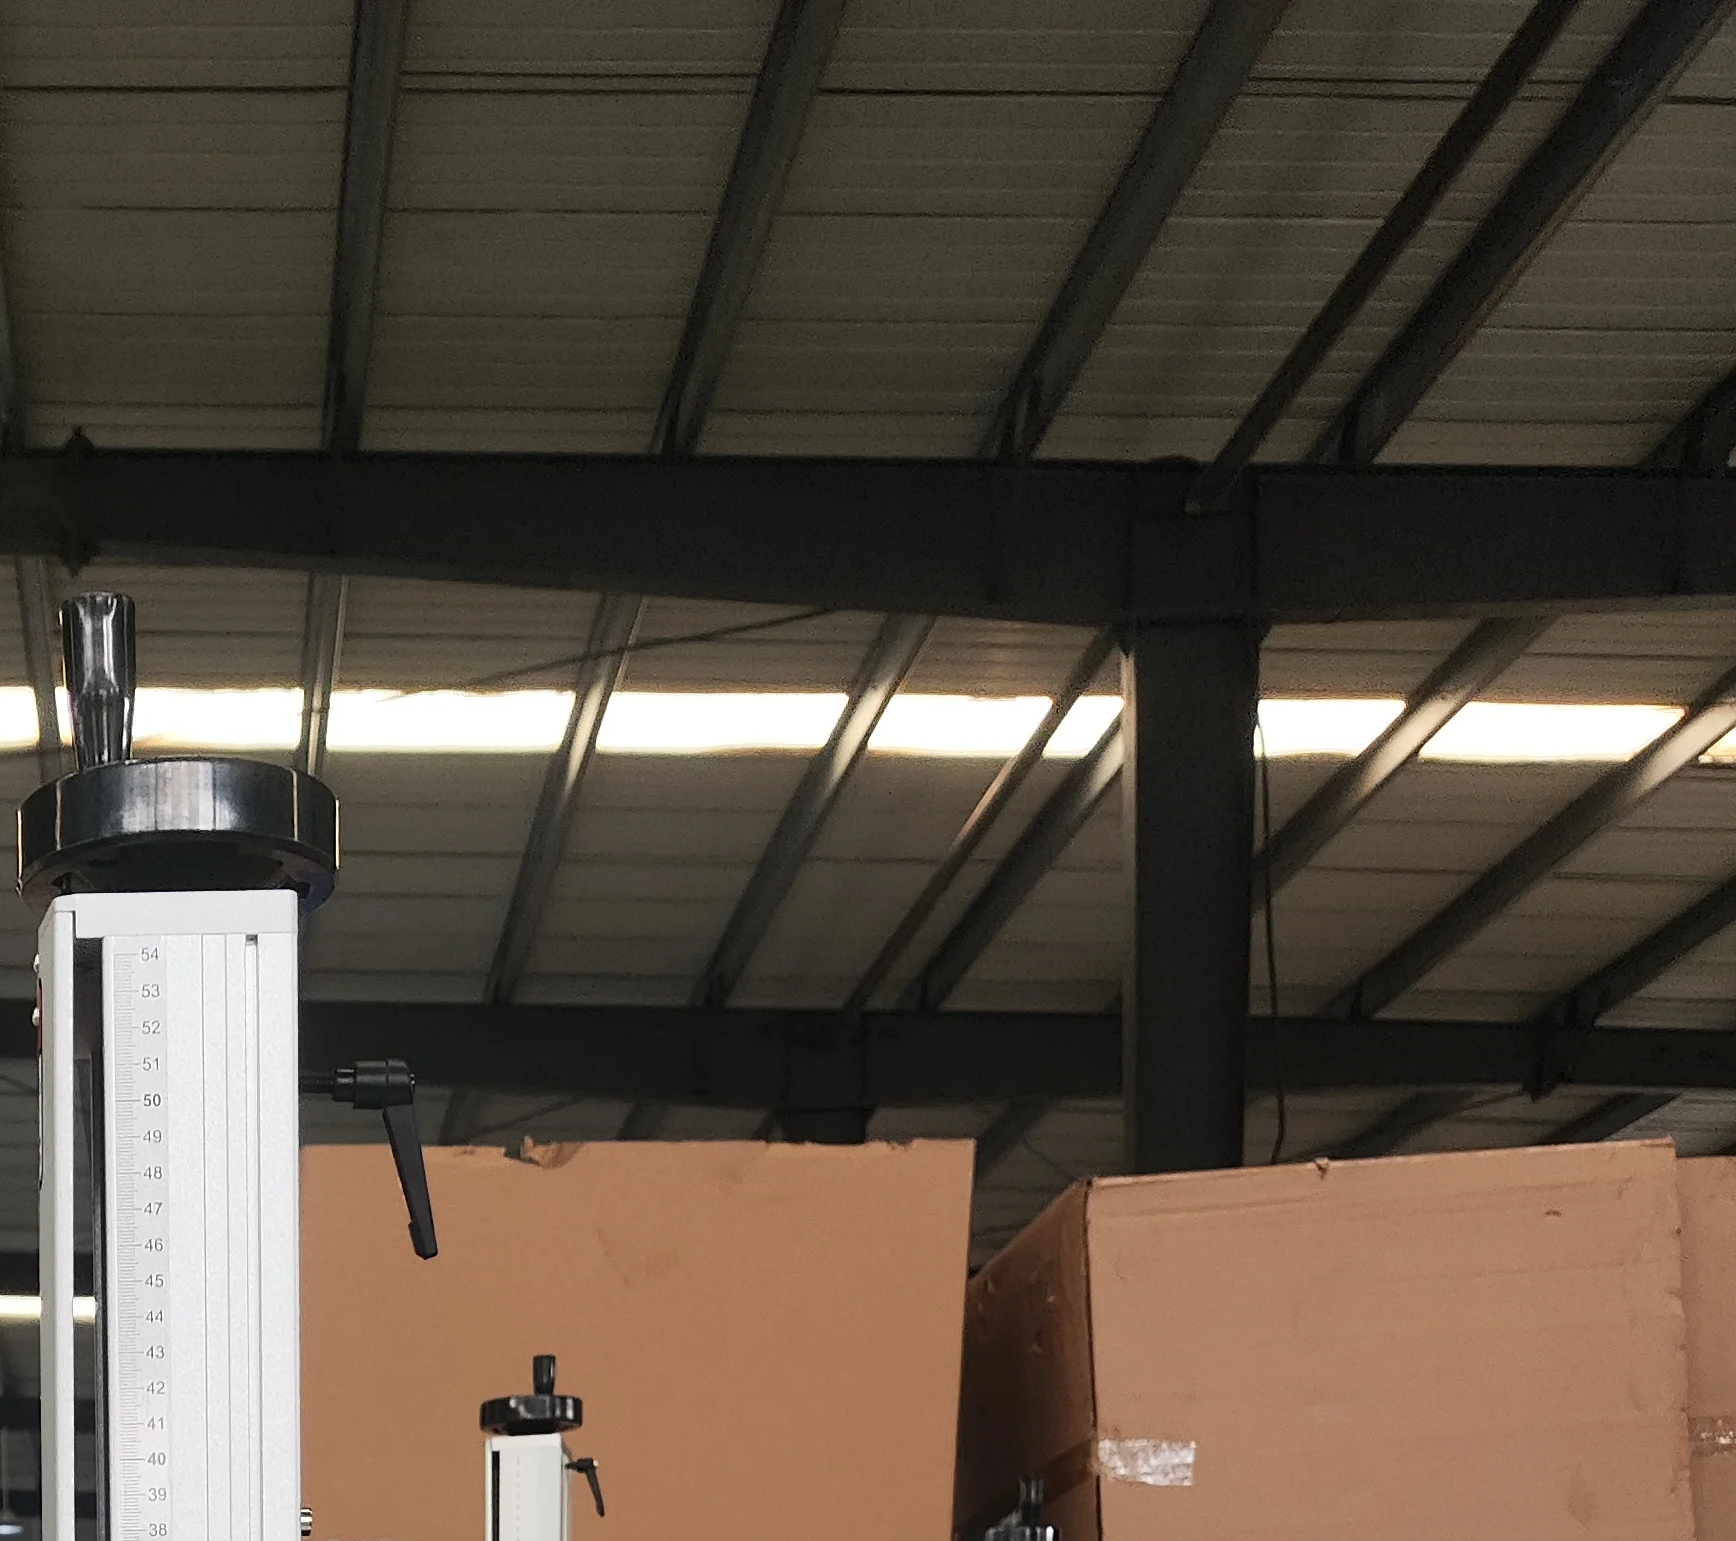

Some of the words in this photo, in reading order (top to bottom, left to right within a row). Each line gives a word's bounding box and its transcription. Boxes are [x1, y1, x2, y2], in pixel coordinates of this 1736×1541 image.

[141, 947, 159, 961] 54
[141, 984, 160, 998] 53
[142, 1020, 160, 1035] 52
[142, 1057, 159, 1072] 51
[143, 1093, 162, 1107] 50
[143, 1129, 162, 1143] 49
[143, 1166, 163, 1180] 48
[143, 1201, 163, 1216] 47
[144, 1238, 164, 1252] 46
[144, 1273, 164, 1288] 45
[145, 1310, 163, 1323] 44
[146, 1345, 165, 1359] 43
[146, 1381, 165, 1395] 42
[146, 1416, 164, 1430] 41
[147, 1452, 166, 1466] 40
[148, 1487, 167, 1502] 39
[149, 1523, 168, 1537] 38
